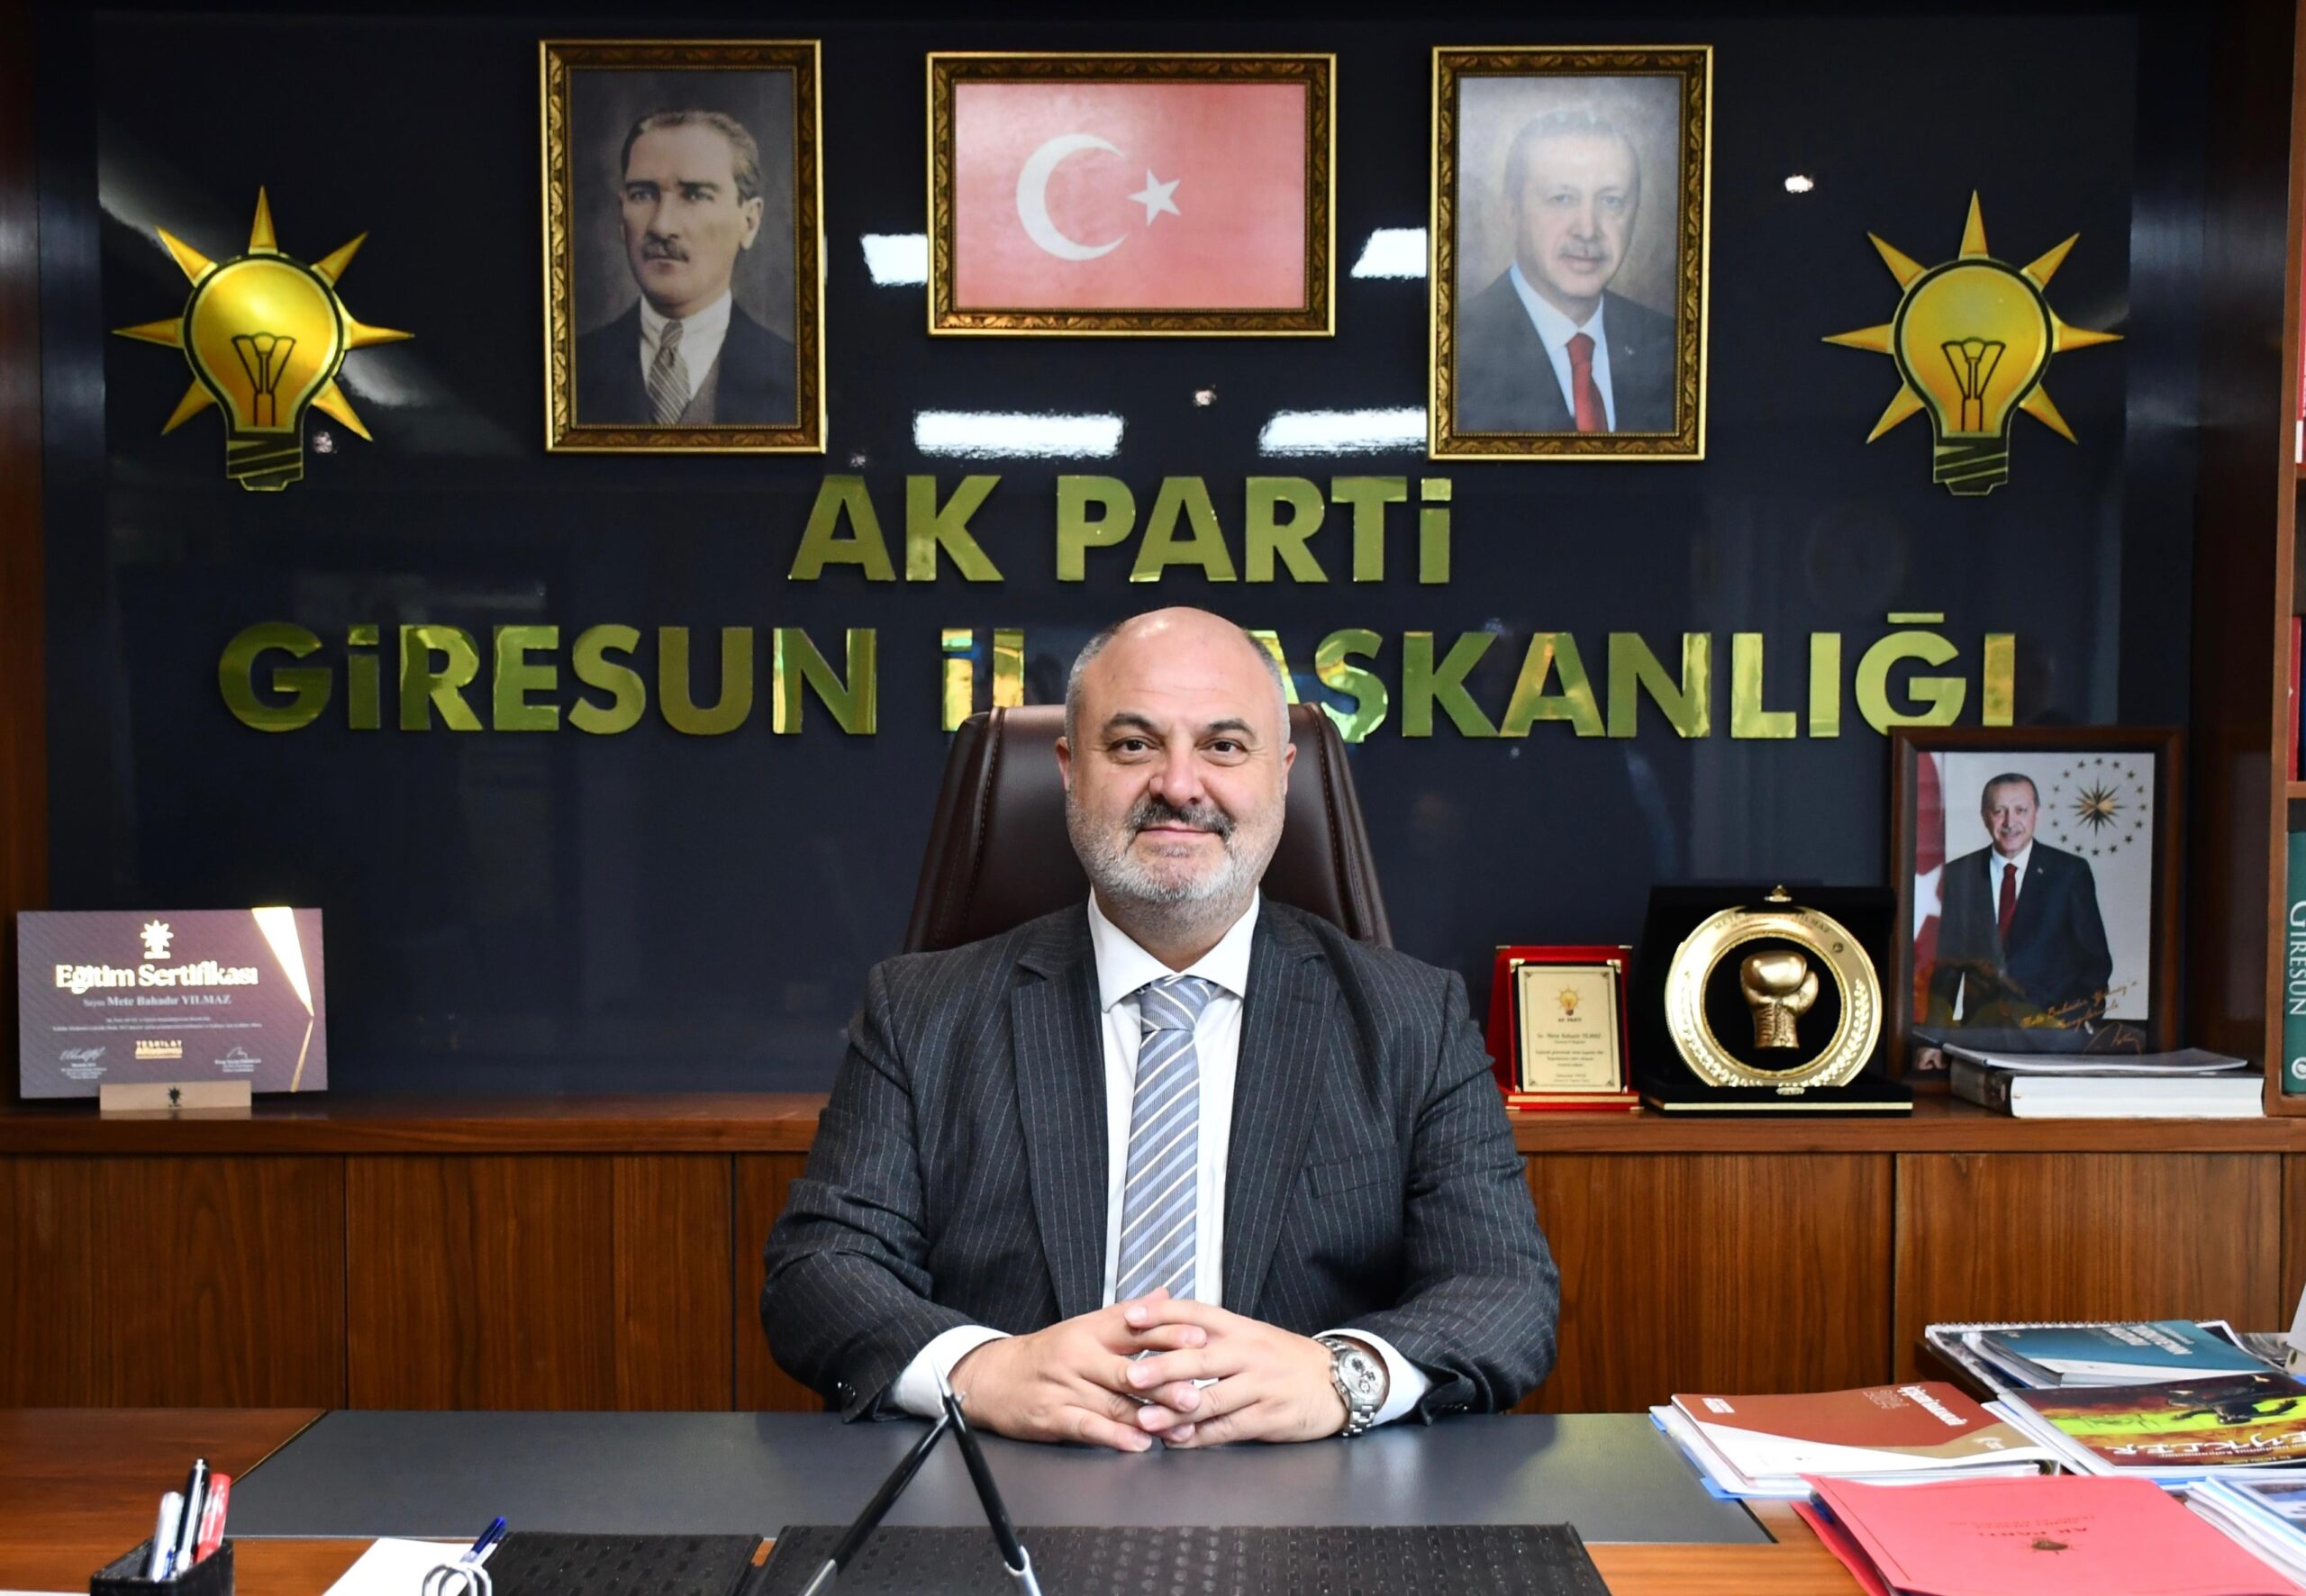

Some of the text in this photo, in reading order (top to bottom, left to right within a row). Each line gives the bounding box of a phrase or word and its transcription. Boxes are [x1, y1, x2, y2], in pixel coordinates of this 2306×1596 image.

[787, 475, 1004, 584] AK
[1246, 612, 2017, 744] ŞKANLIĞI
[55, 960, 259, 994] Eğitim Sertifikası
[107, 996, 134, 1007] Mete
